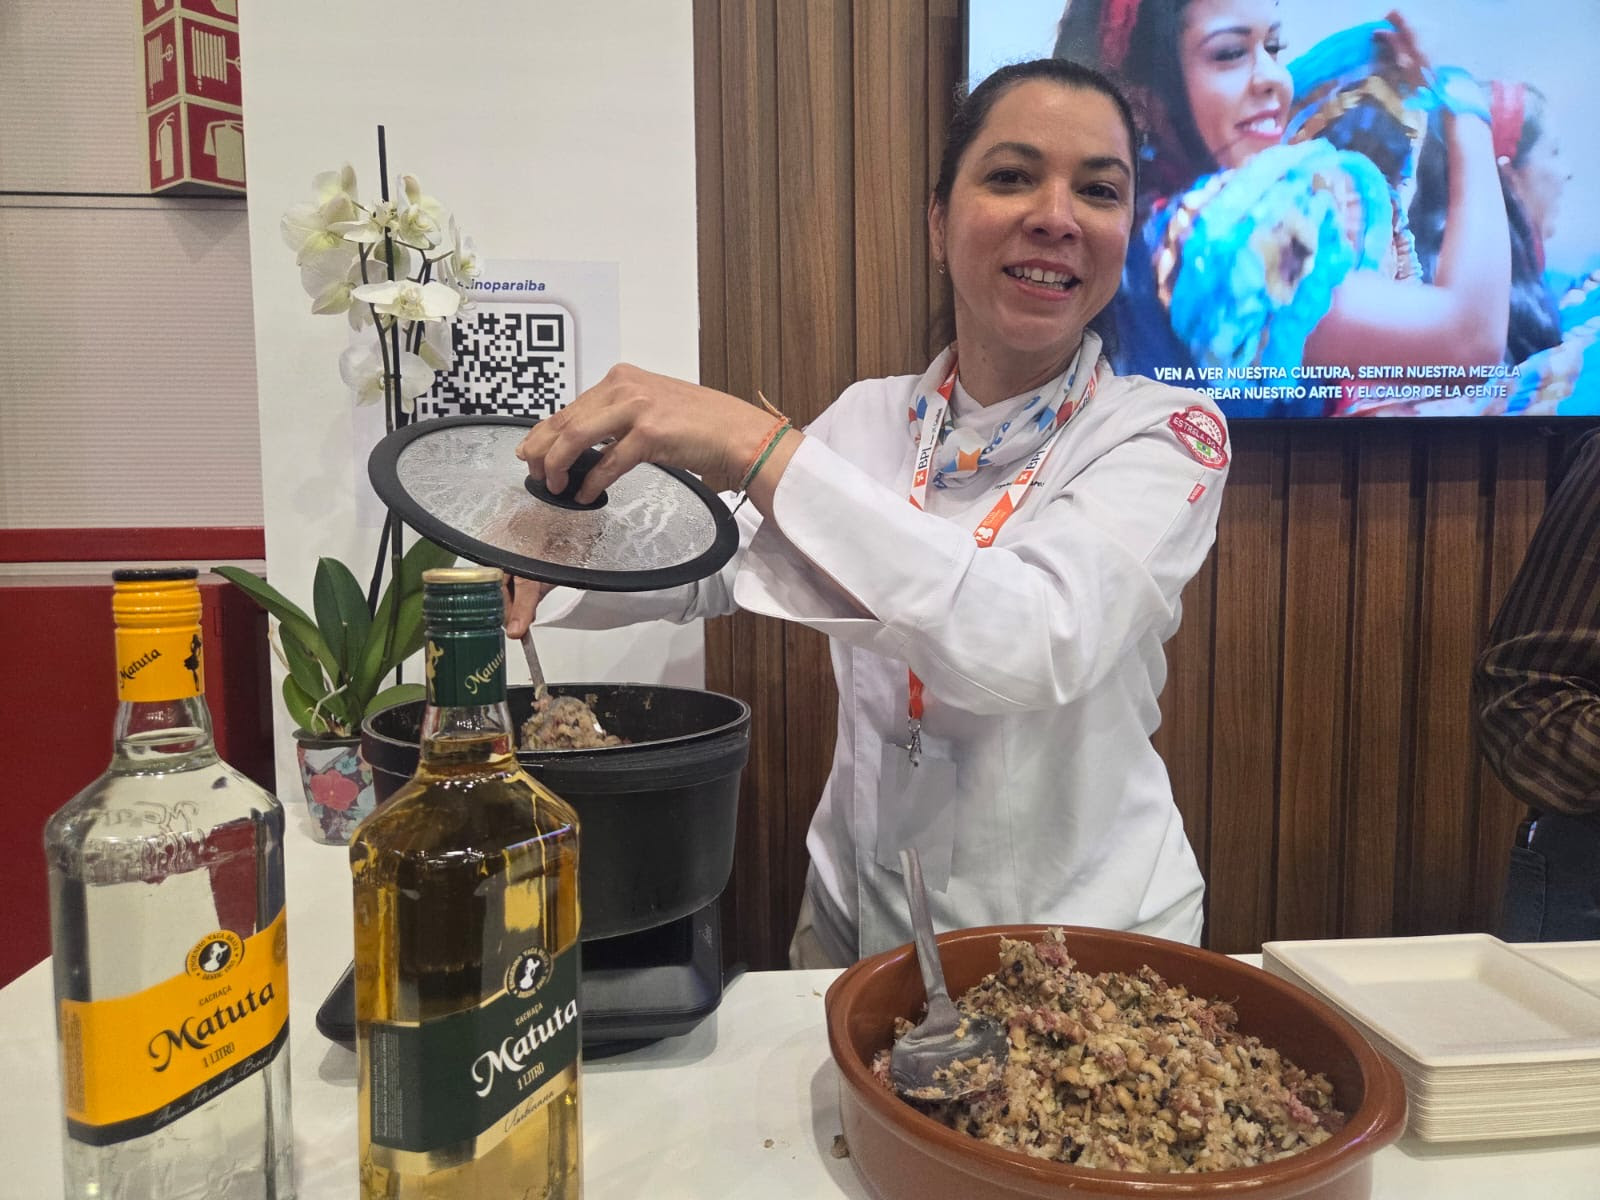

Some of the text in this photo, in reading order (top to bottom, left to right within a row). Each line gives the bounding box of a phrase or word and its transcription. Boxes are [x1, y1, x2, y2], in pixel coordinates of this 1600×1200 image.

[1154, 366, 1521, 381] VEN A VER NUESTRA CULTURA, SENTIR NUESTRA MEZCLA
[1245, 387, 1306, 399] NUESTRO
[1309, 386, 1342, 398] ARTE
[1345, 386, 1355, 398] Y
[1358, 386, 1372, 398] EL
[1375, 386, 1421, 397] CALOR
[1424, 386, 1442, 397] DE
[1445, 385, 1461, 397] LA
[1464, 385, 1507, 397] GENTE
[918, 446, 932, 470] BPI
[1025, 450, 1046, 470] BPI
[198, 984, 233, 1006] CACHAÇA
[515, 1003, 544, 1026] CACHAÇA
[148, 981, 276, 1073] Matuta
[202, 1041, 236, 1068] 1 LITRO
[471, 999, 578, 1098] Matuta
[517, 1062, 545, 1091] 1 LITRO
